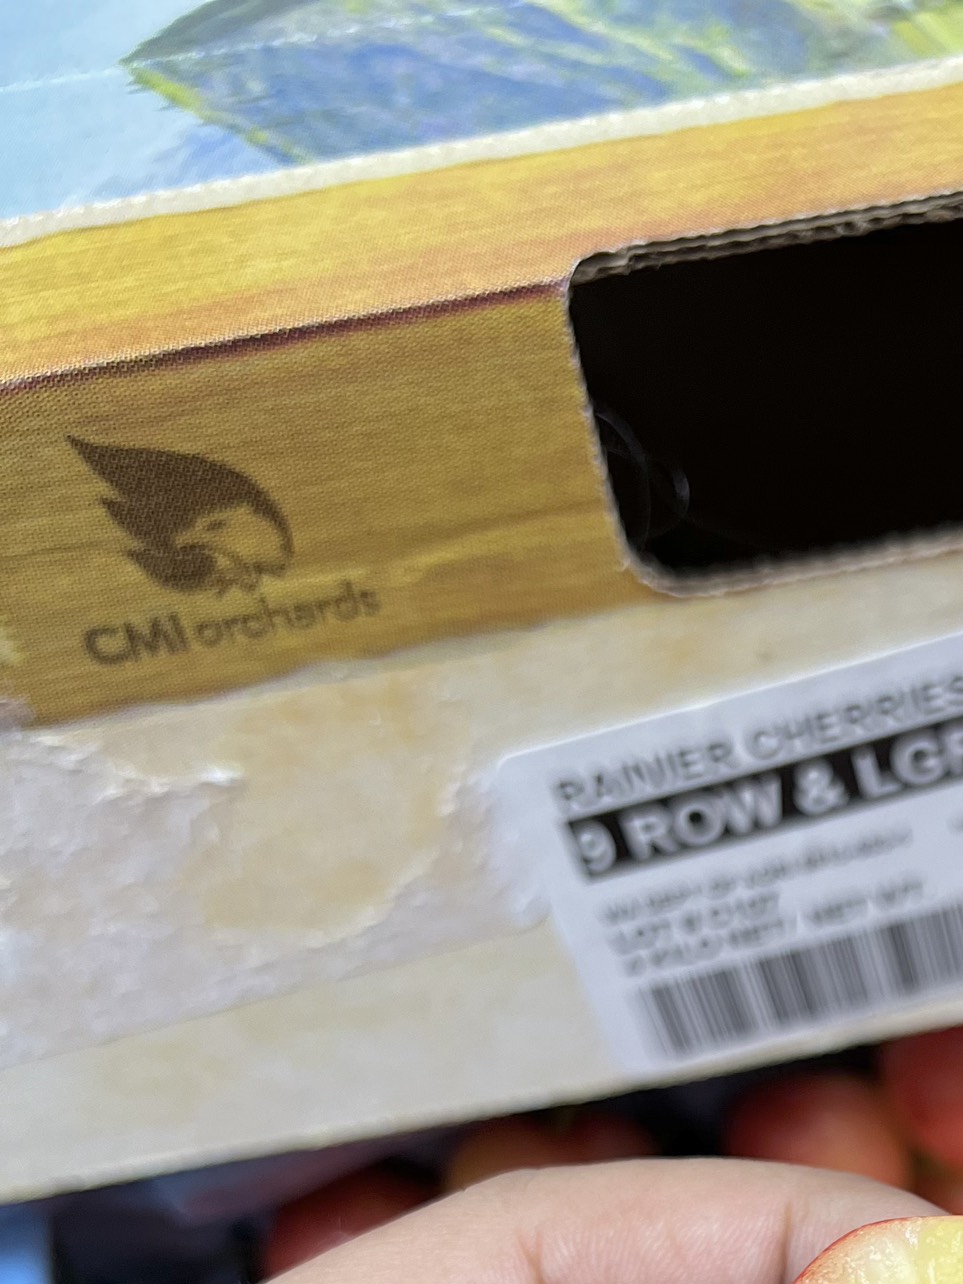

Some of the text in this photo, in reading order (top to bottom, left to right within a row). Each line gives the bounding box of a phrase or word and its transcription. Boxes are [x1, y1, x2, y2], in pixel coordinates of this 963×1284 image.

[84, 579, 382, 665] CMI orchards
[554, 738, 738, 810] RAINIER
[576, 819, 616, 875] 9
[619, 770, 783, 862] ROW
[792, 757, 850, 817] &
